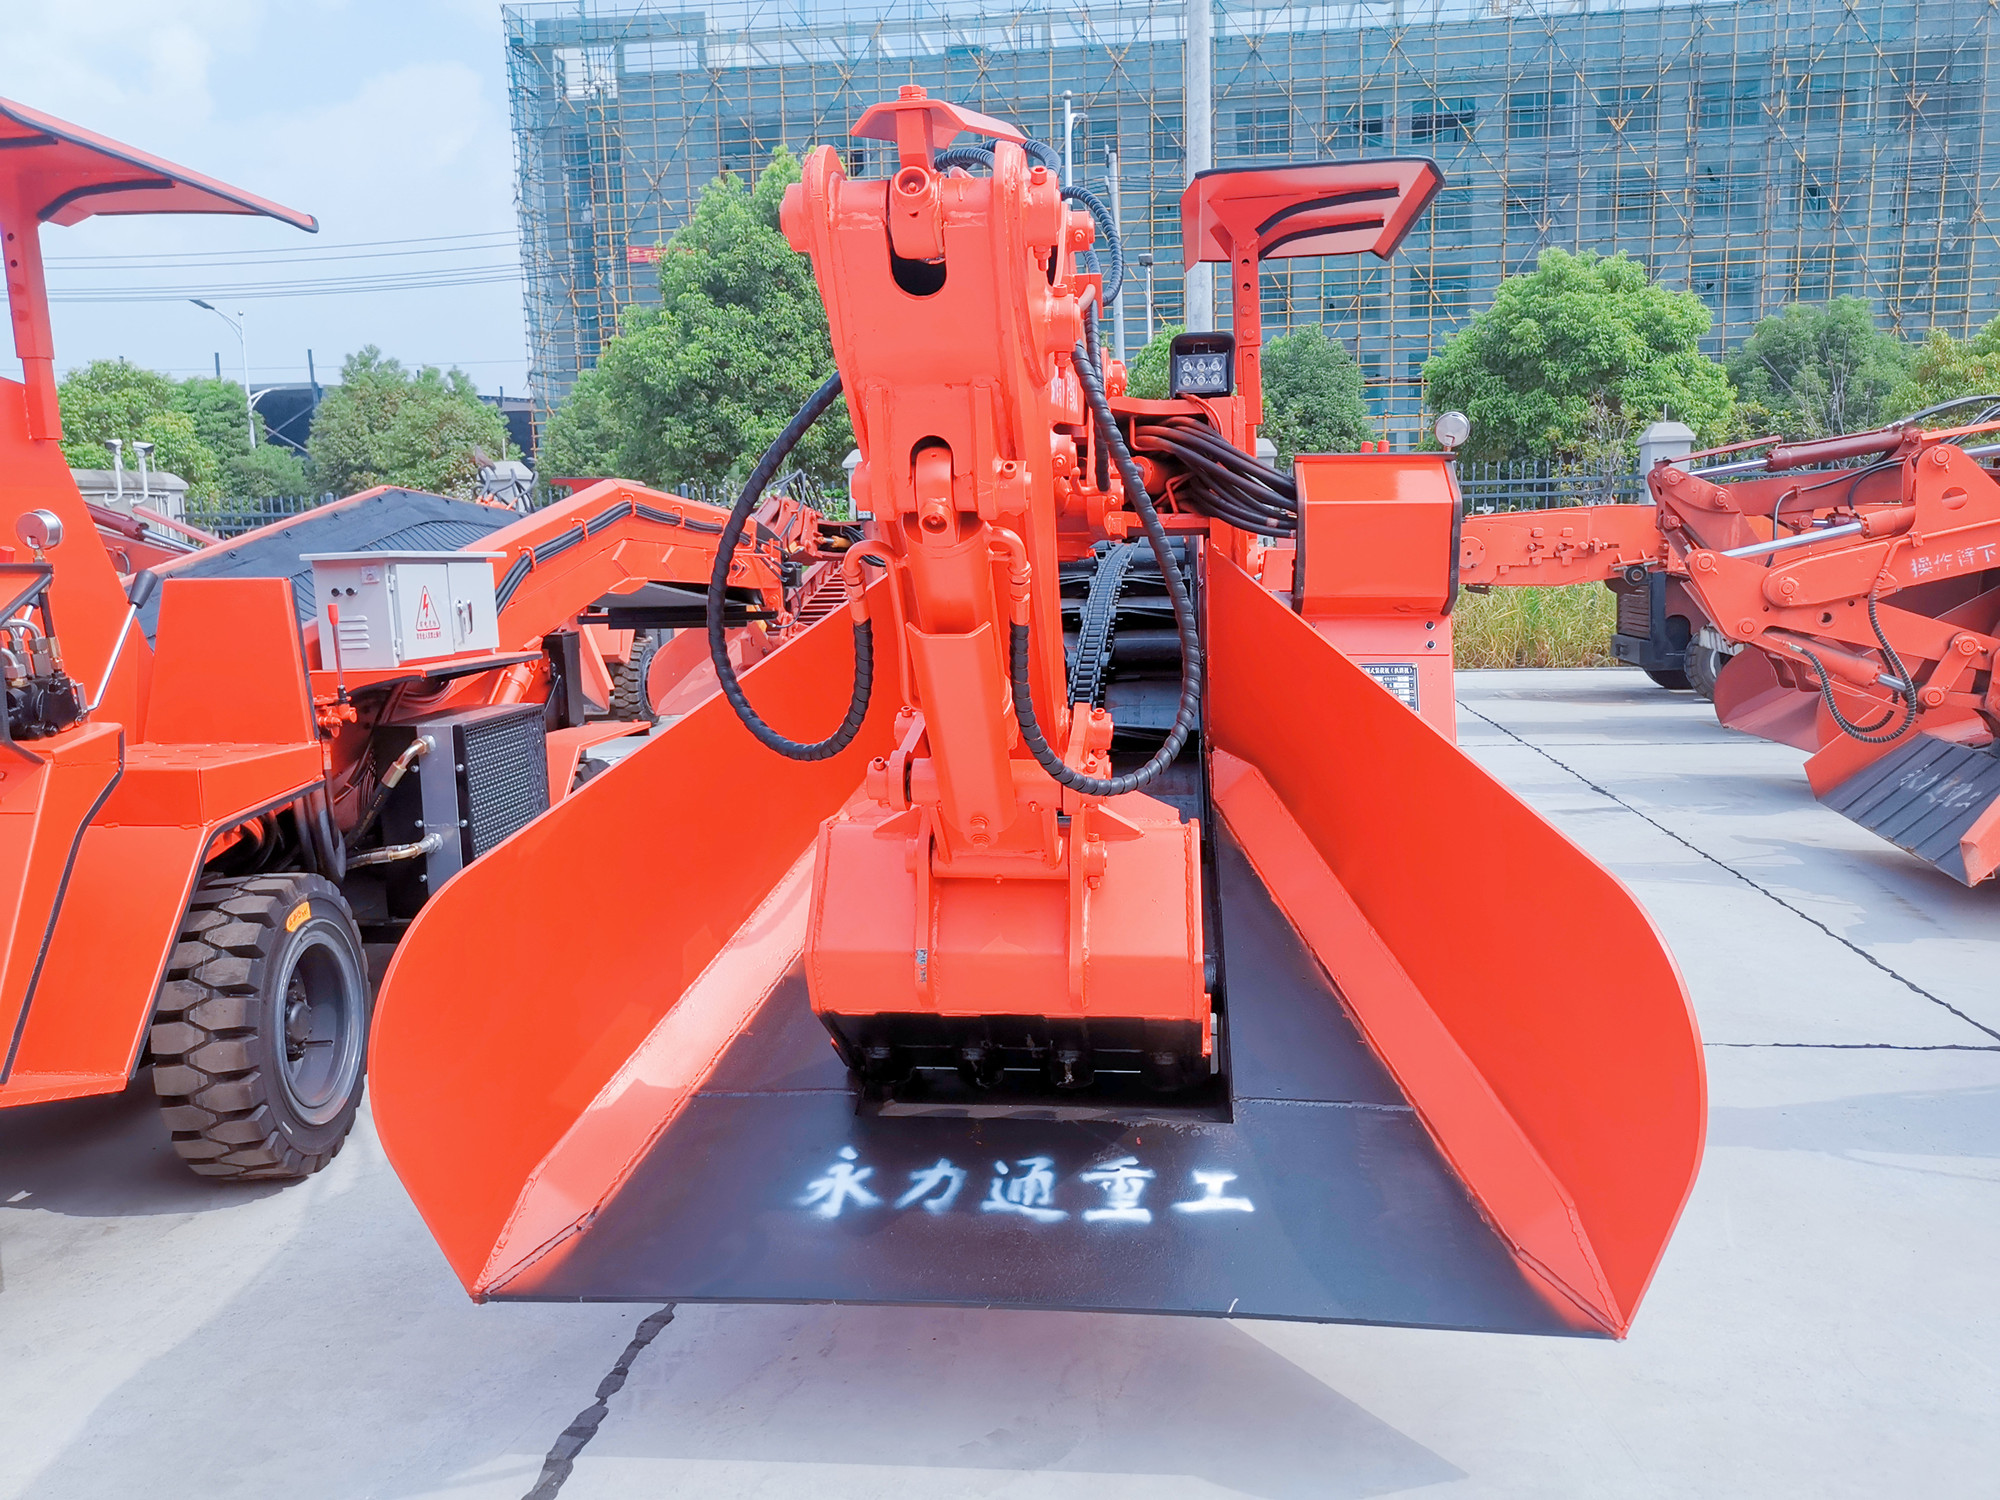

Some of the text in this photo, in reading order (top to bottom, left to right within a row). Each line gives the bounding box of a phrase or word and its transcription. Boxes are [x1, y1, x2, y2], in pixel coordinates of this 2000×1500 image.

[801, 1145, 1256, 1223] 永力通重工
